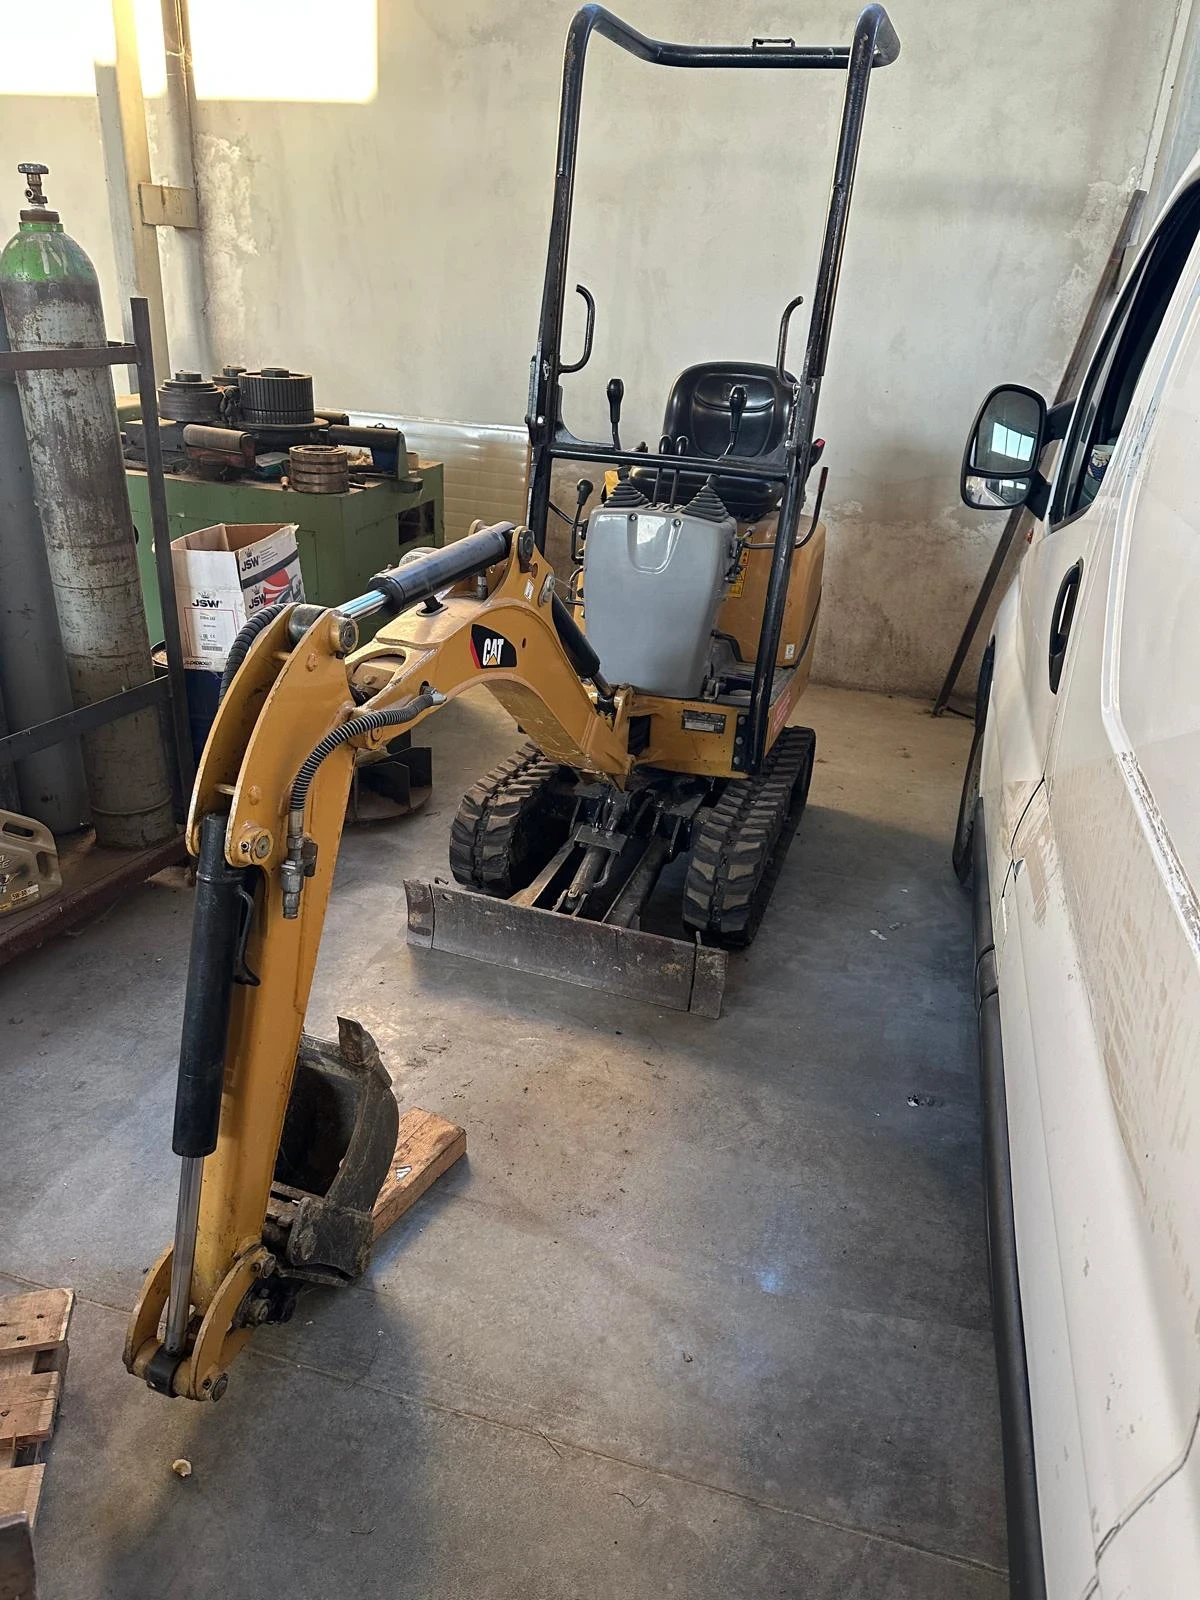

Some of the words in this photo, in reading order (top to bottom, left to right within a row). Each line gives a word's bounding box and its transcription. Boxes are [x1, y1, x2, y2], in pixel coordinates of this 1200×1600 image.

[241, 555, 260, 572] JSW
[192, 599, 219, 608] JSW
[249, 593, 267, 609] JSW
[482, 638, 505, 666] CAT
